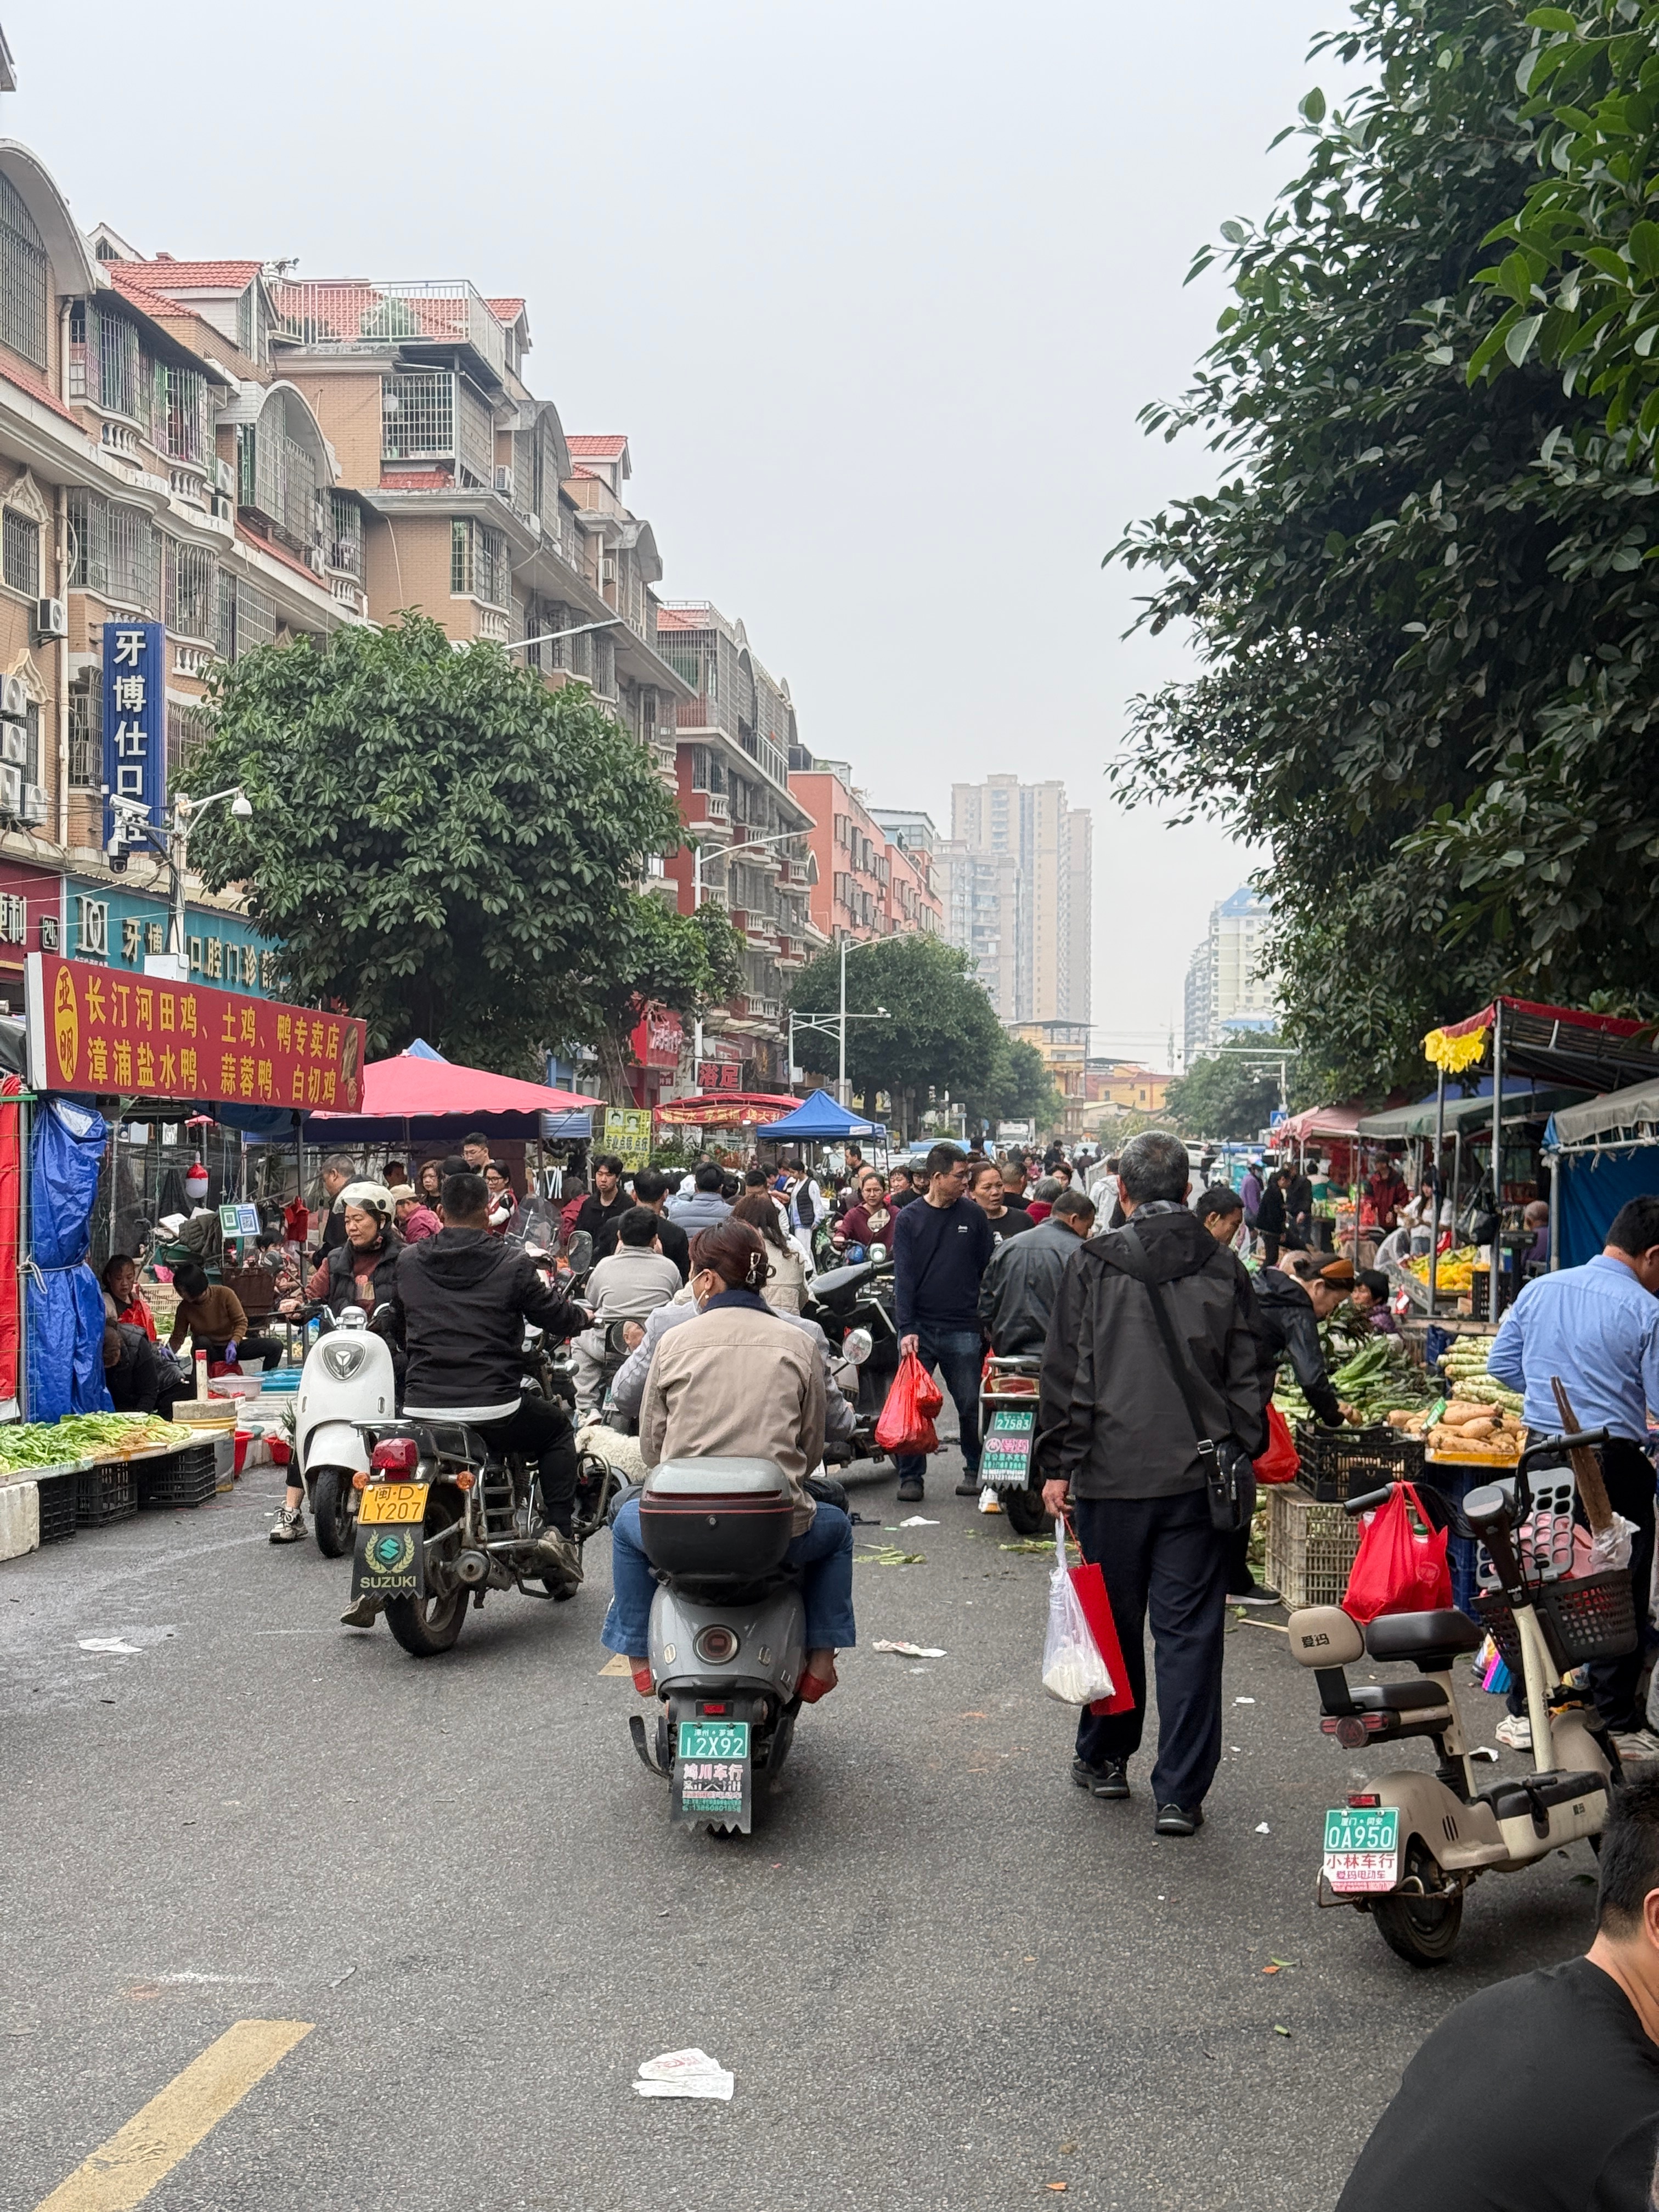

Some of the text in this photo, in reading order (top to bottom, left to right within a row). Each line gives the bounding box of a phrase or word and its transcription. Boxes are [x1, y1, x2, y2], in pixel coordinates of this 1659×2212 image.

[699, 1063, 739, 1088] 浴足
[997, 1419, 1029, 1429] 27583
[362, 1502, 421, 1521] LY207
[360, 1576, 416, 1588] SUZUKI
[1301, 1633, 1330, 1649] 爱玛
[687, 1737, 743, 1756] 12X92
[1328, 1826, 1392, 1848] 0A950
[1327, 1853, 1395, 1869] 小林车行
